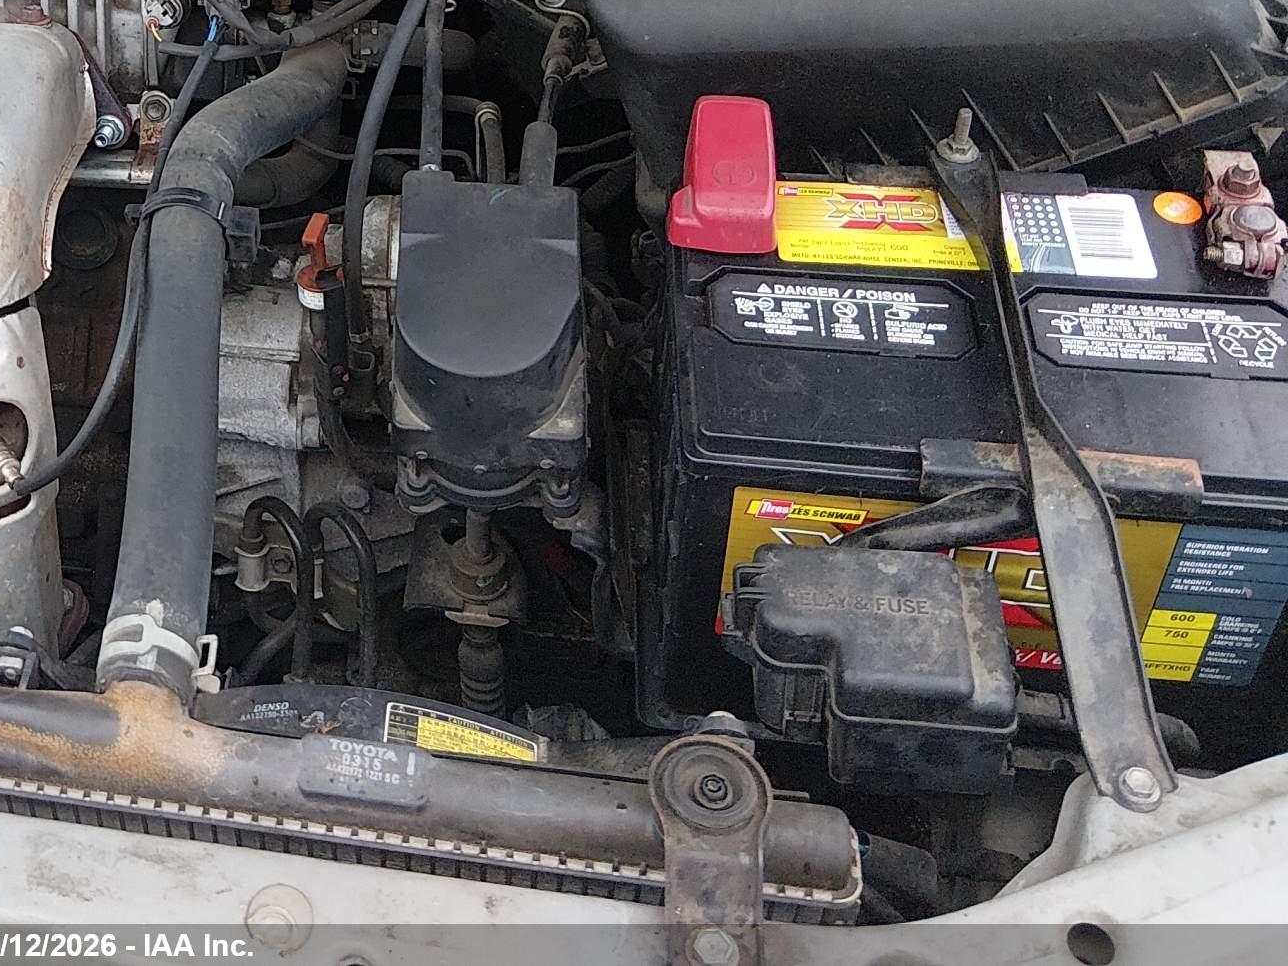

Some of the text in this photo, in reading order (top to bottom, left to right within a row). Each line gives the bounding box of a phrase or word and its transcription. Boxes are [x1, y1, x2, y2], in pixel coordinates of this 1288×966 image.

[823, 198, 938, 223] XHD
[774, 284, 839, 298] DANGER
[855, 289, 916, 303] POISON
[885, 320, 948, 331] SULFURIC ACID
[1079, 316, 1189, 330] FLUSH EYES IMMEDIATELY
[1083, 330, 1168, 341] MEDICAL HELP FAST
[1138, 326, 1156, 334] GET
[812, 509, 861, 521] SCHWAB
[1183, 548, 1232, 558] RESISTANCE
[1185, 541, 1270, 554] SUPERIOR VIBRATION
[1179, 560, 1228, 570] ENGINEERED
[1176, 567, 1235, 577] EXTENDED LIFE
[1182, 578, 1213, 586] MONTH
[854, 594, 870, 611] &
[875, 596, 930, 615] FUSE
[1170, 613, 1196, 623] 600
[1163, 630, 1253, 642] 750 CRANKING
[1211, 639, 1234, 647] AMPS
[1206, 650, 1237, 658] MONTH
[1205, 656, 1249, 665] WARRANTY
[253, 701, 290, 713] DENSO
[329, 738, 398, 763] TOYOTA
